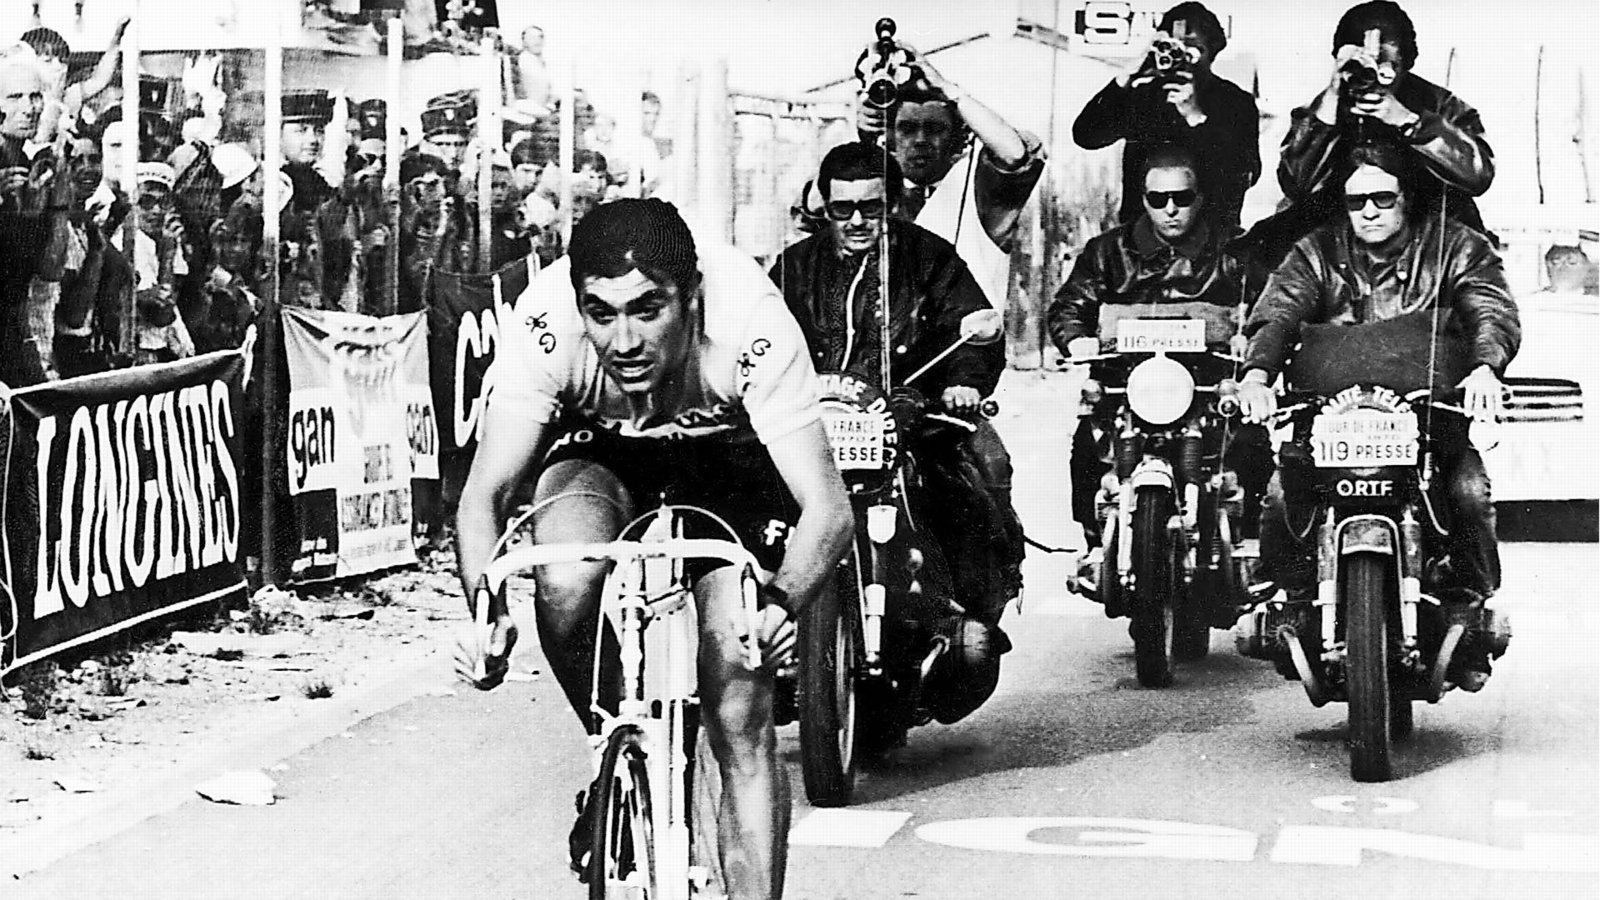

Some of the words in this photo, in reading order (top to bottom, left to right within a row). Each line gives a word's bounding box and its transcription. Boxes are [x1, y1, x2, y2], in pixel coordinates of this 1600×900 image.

[291, 405, 336, 489] gan
[1319, 440, 1349, 462] 119
[1355, 443, 1412, 460] PRESSE
[33, 379, 240, 620] LONGINES
[1336, 478, 1394, 497] ORTF
